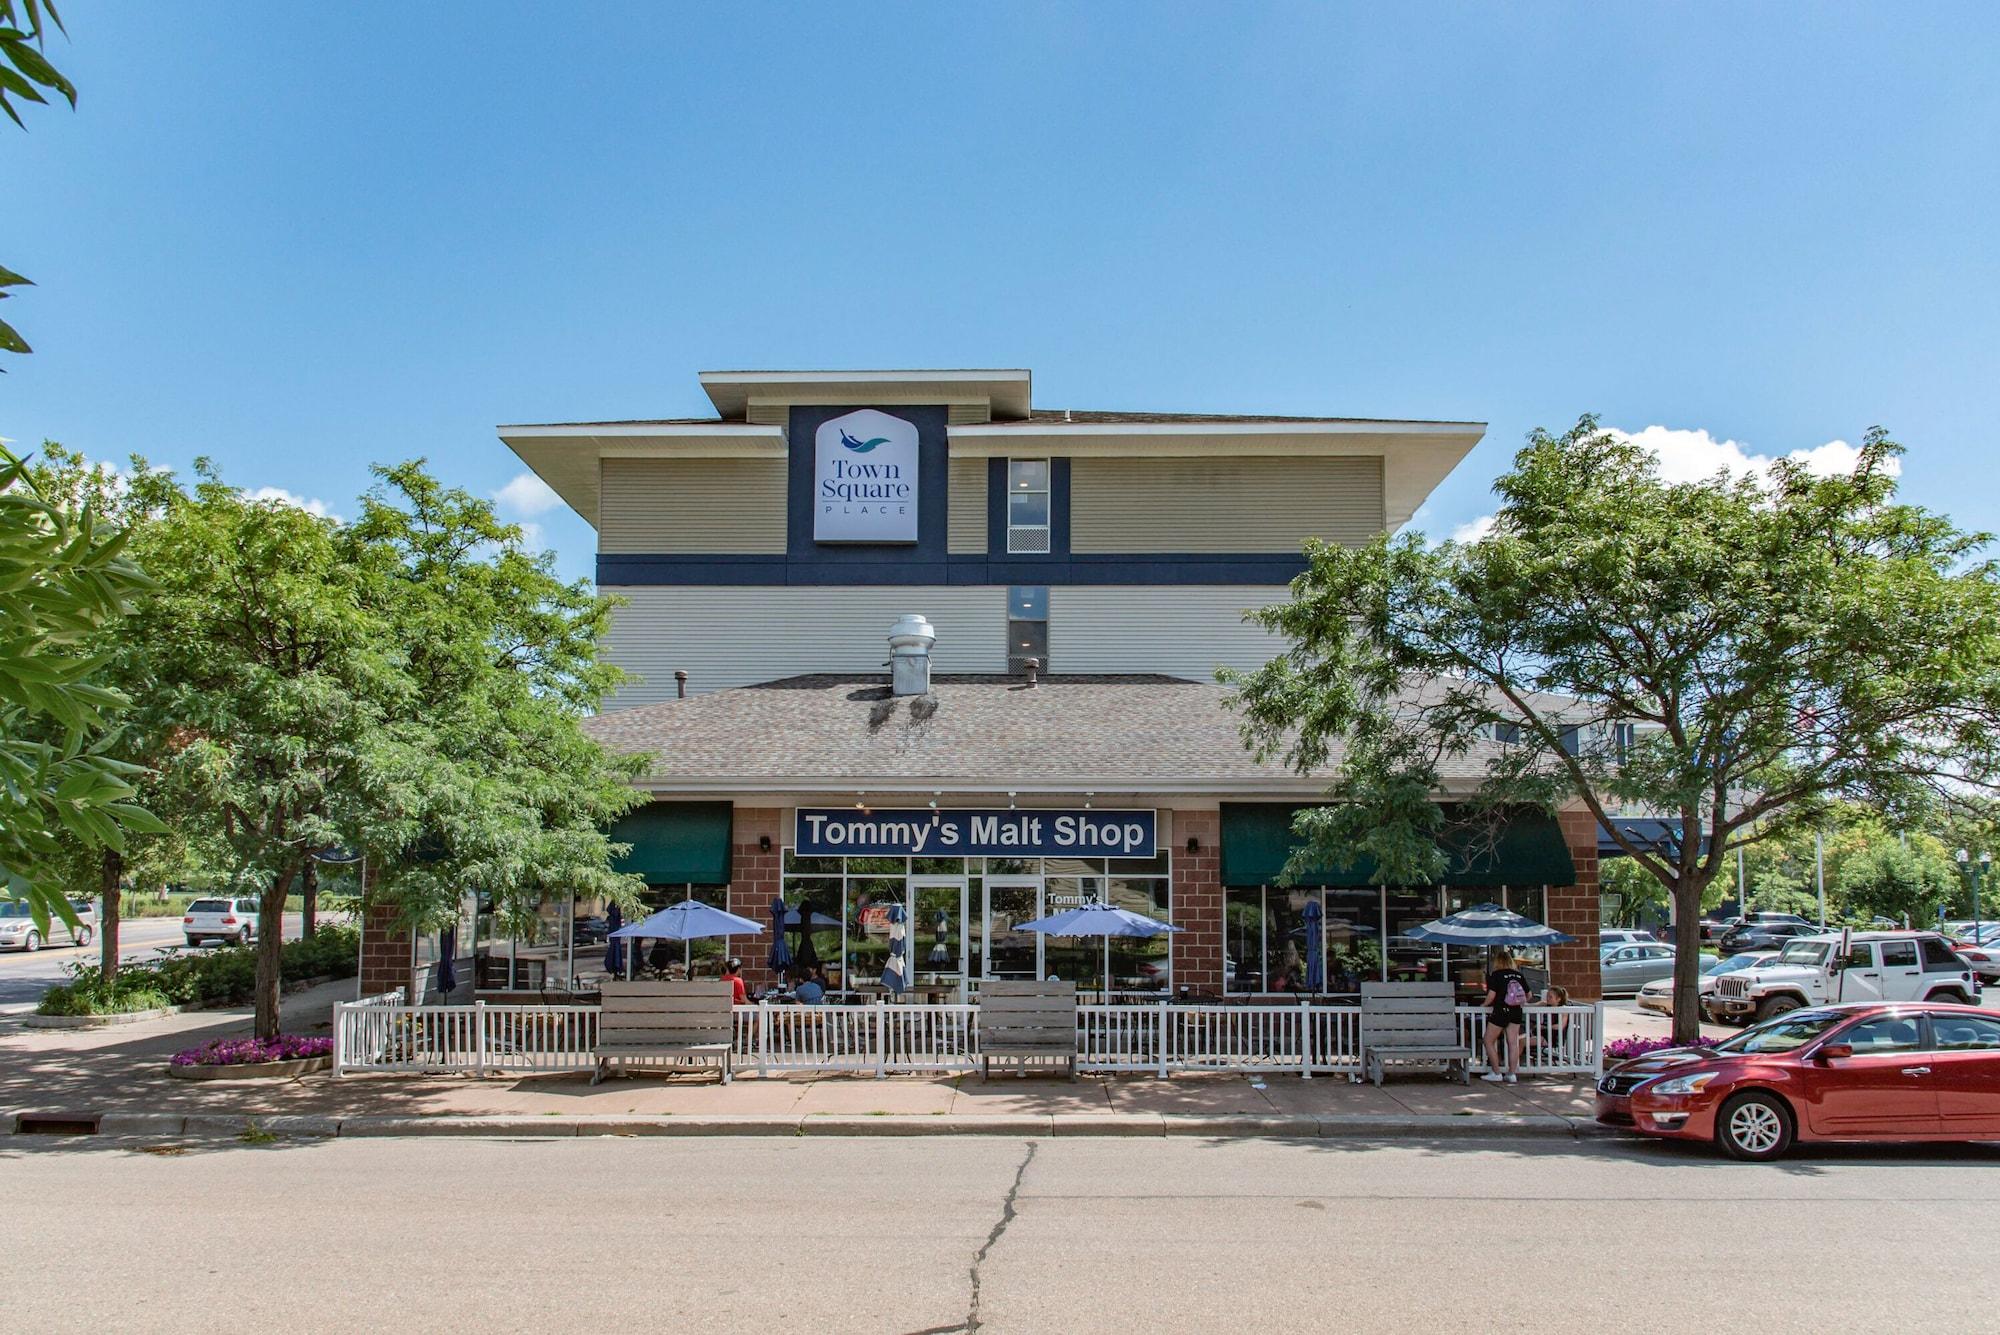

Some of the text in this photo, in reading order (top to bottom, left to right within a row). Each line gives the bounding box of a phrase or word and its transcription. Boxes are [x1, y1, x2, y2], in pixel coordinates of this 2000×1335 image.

[832, 460, 900, 478] Town
[822, 480, 910, 502] Square
[825, 505, 905, 515] PLACE
[805, 815, 1144, 853] Tommy's Malt Shop
[1048, 892, 1104, 907] Tommy's
